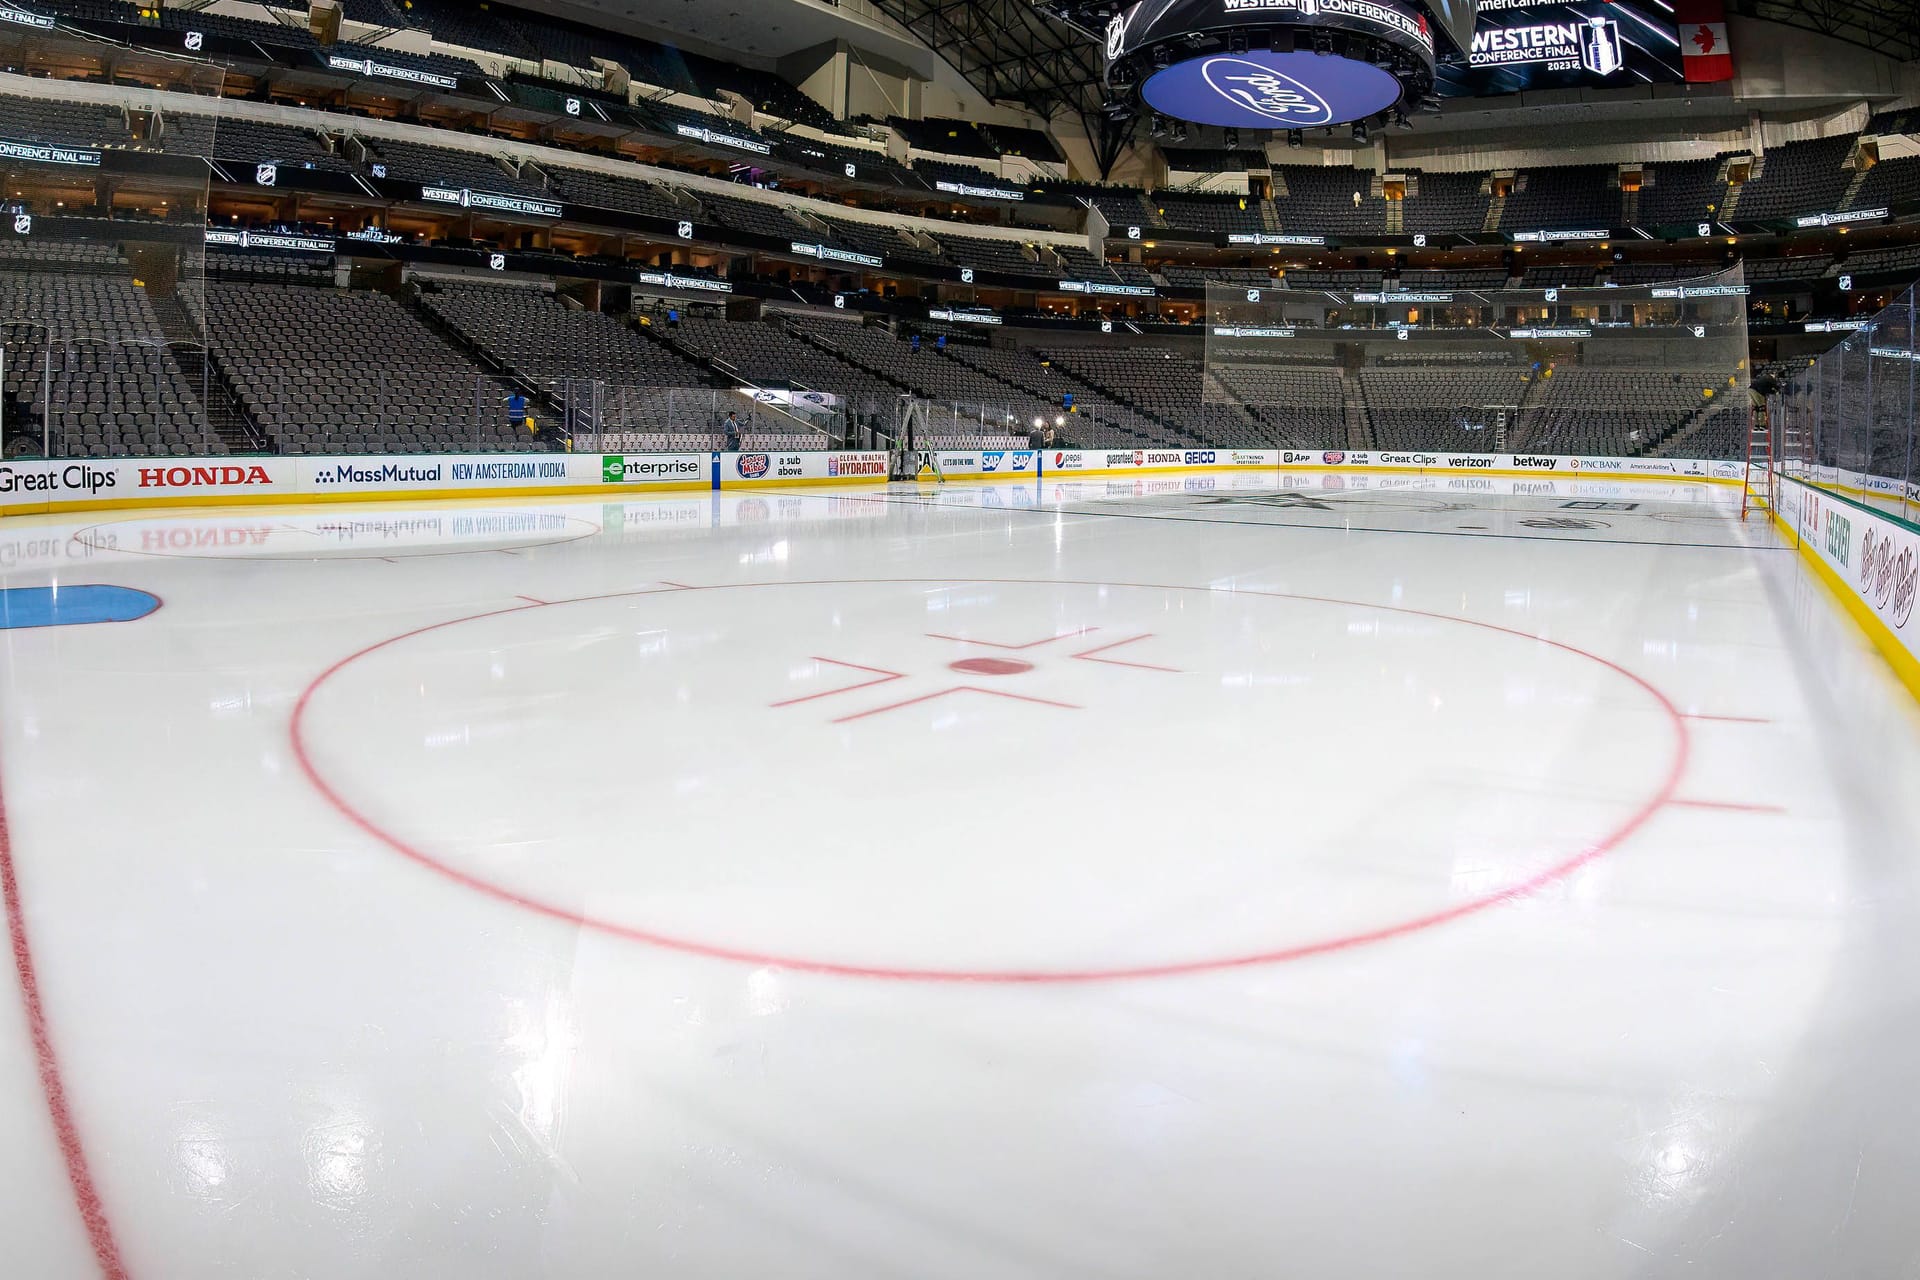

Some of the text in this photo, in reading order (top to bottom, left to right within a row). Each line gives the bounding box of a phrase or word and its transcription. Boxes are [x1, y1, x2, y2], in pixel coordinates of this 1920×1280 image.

[14, 13, 35, 25] FINAL
[1321, 0, 1401, 26] CONFERENCE
[1471, 23, 1578, 53] WESTERN
[1469, 45, 1579, 64] CONFERENCE FINAL
[330, 58, 363, 70] WESTERN
[374, 65, 420, 81] CONFERENCE
[420, 73, 440, 85] FINAL
[1547, 62, 1571, 71] 2023
[1225, 73, 1320, 113] Ford
[52, 150, 79, 162] FINAL
[422, 189, 460, 201] WESTERN
[471, 194, 521, 209] CONFERENCE
[522, 203, 545, 213] FINAL
[205, 233, 239, 242] WESTERN
[250, 235, 297, 247] CONFERENCE
[297, 240, 318, 248] FINAL
[786, 456, 801, 464] sub
[982, 455, 999, 467] SAP
[1013, 455, 1029, 467] SAP
[1065, 453, 1082, 463] pepsi
[1147, 453, 1181, 463] HONDA
[1185, 451, 1216, 464] GEICO
[1380, 453, 1437, 466] Great Clips
[1448, 456, 1491, 467] verizon
[1513, 456, 1557, 469] betway
[337, 463, 441, 482] MassMutual
[452, 462, 566, 480] NEW AMSTERDAM VODKA
[609, 460, 698, 477] enterprise
[777, 466, 802, 475] above
[839, 462, 887, 475] HYDRATION.
[0, 466, 116, 494] Great Clips
[138, 466, 273, 487] HONDA
